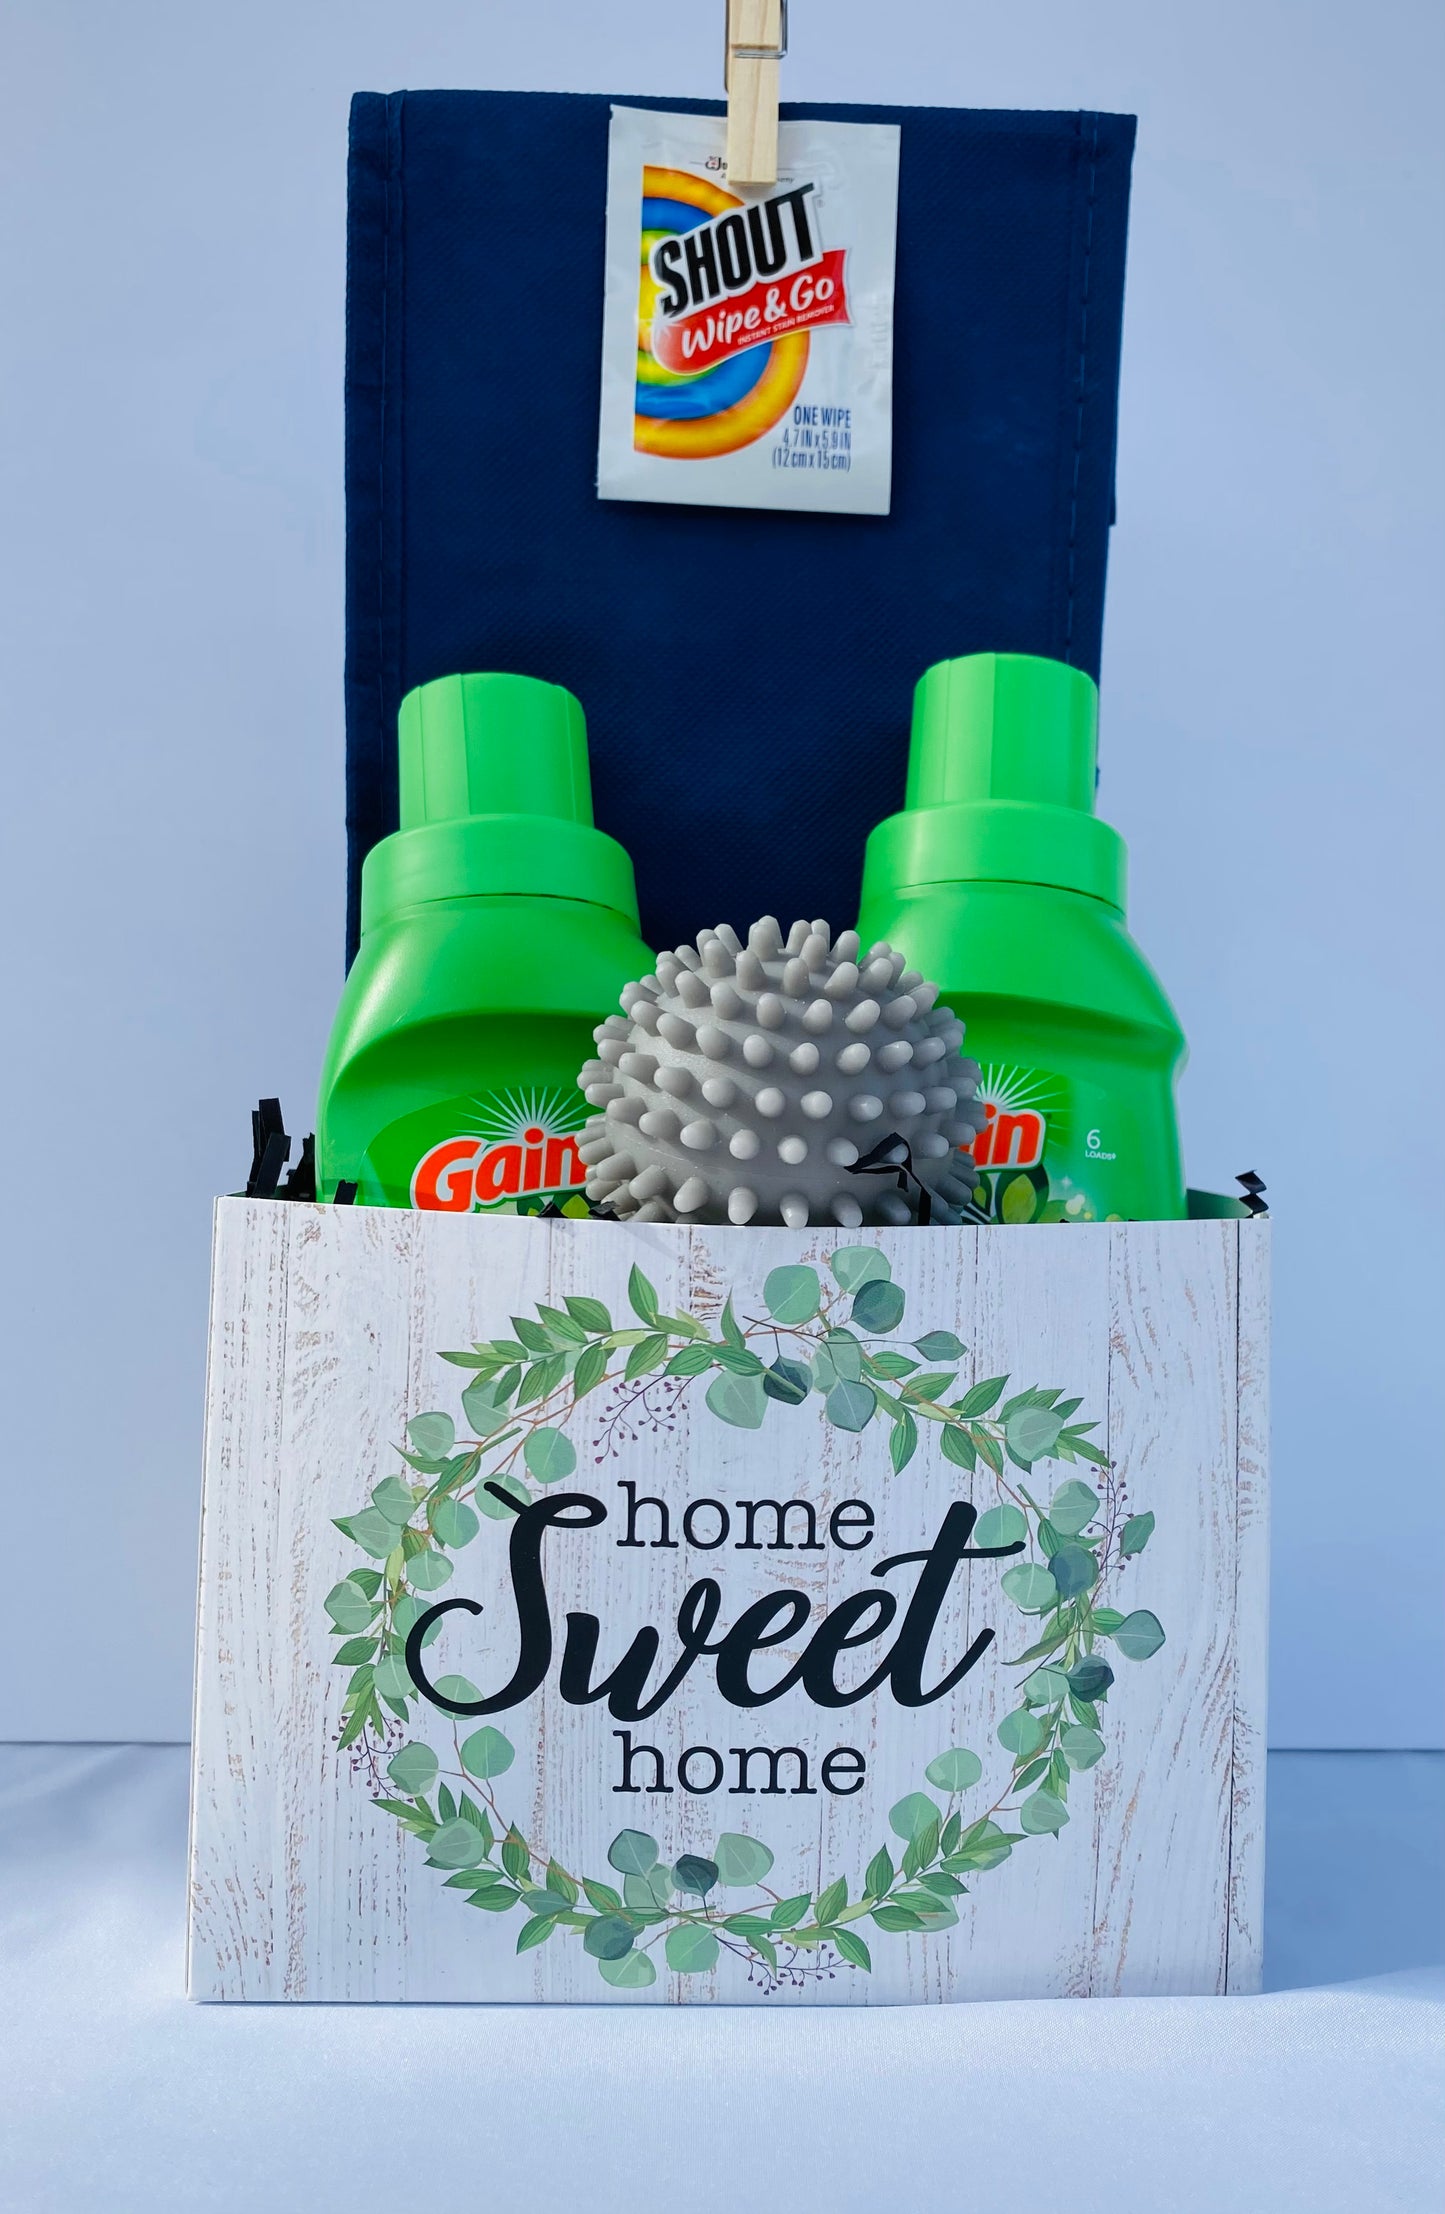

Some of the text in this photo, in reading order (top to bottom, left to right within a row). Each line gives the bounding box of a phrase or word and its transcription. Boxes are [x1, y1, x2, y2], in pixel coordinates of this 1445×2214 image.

[655, 182, 814, 318] SHOUT
[681, 306, 762, 359] Wipe
[790, 274, 834, 312] Go
[737, 304, 835, 345] INSTANT STAIN REMOVER
[794, 405, 851, 429] ONE WIPE
[959, 1103, 1041, 1167] in
[1087, 1129, 1100, 1149] 6
[413, 1127, 587, 1212] Gain
[617, 1481, 875, 1551] home
[405, 1481, 1026, 1722] Sweet
[612, 1730, 867, 1796] home
